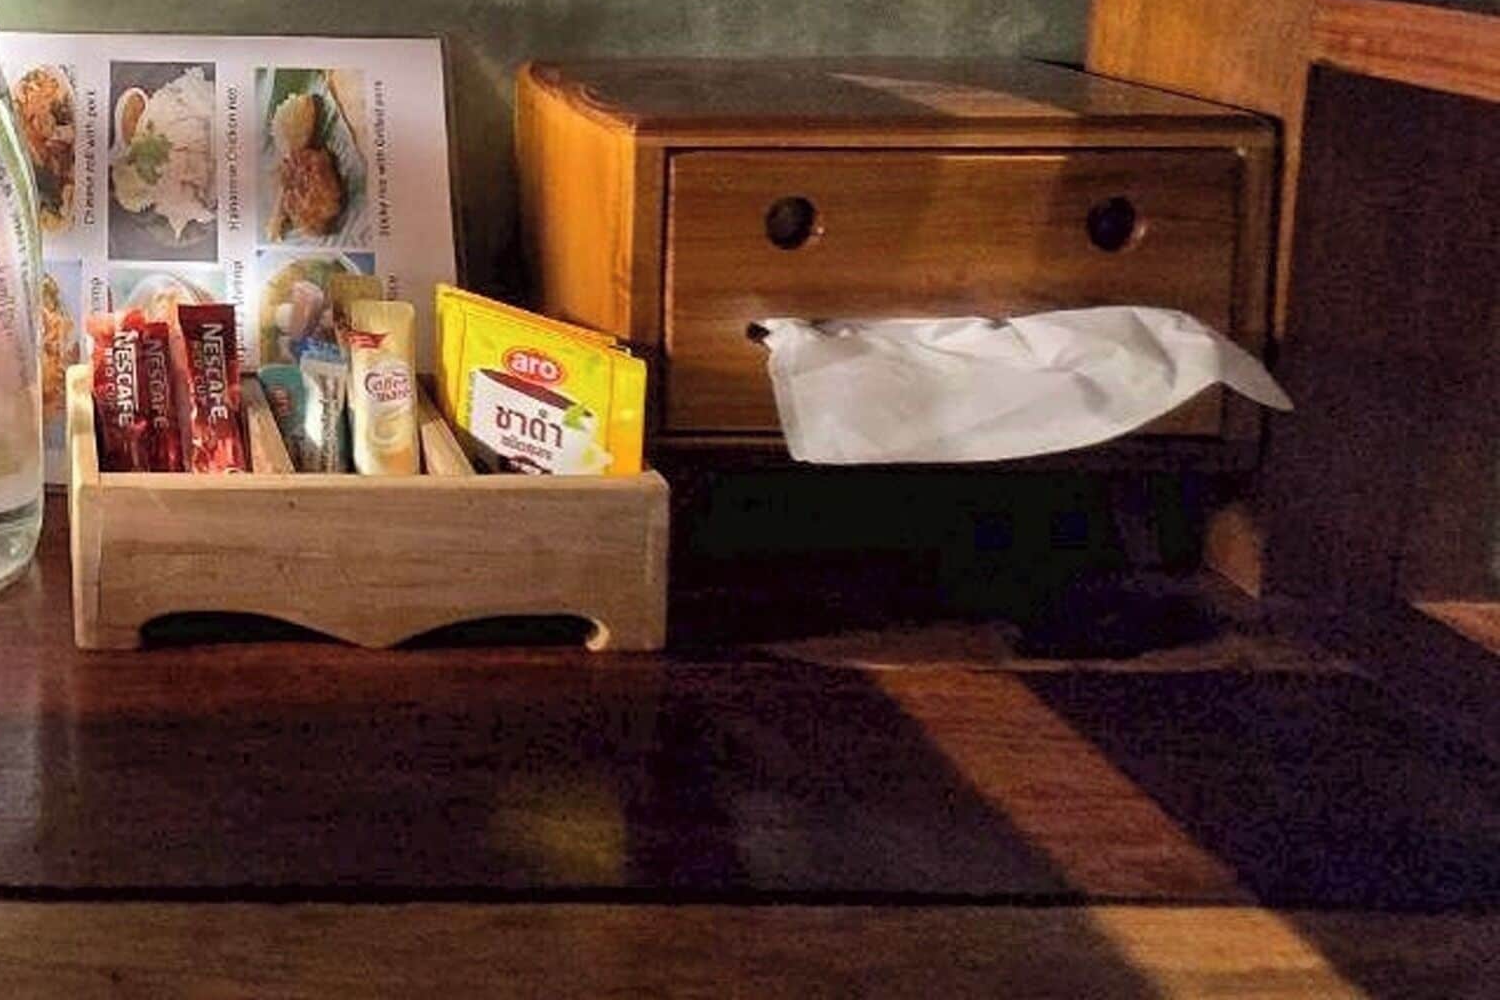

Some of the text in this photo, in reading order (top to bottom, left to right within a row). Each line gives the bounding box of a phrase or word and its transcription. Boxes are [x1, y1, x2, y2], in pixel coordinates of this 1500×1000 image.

[226, 113, 238, 161] Chicken
[512, 353, 559, 381] aro
[496, 405, 564, 448] ชาดำ
